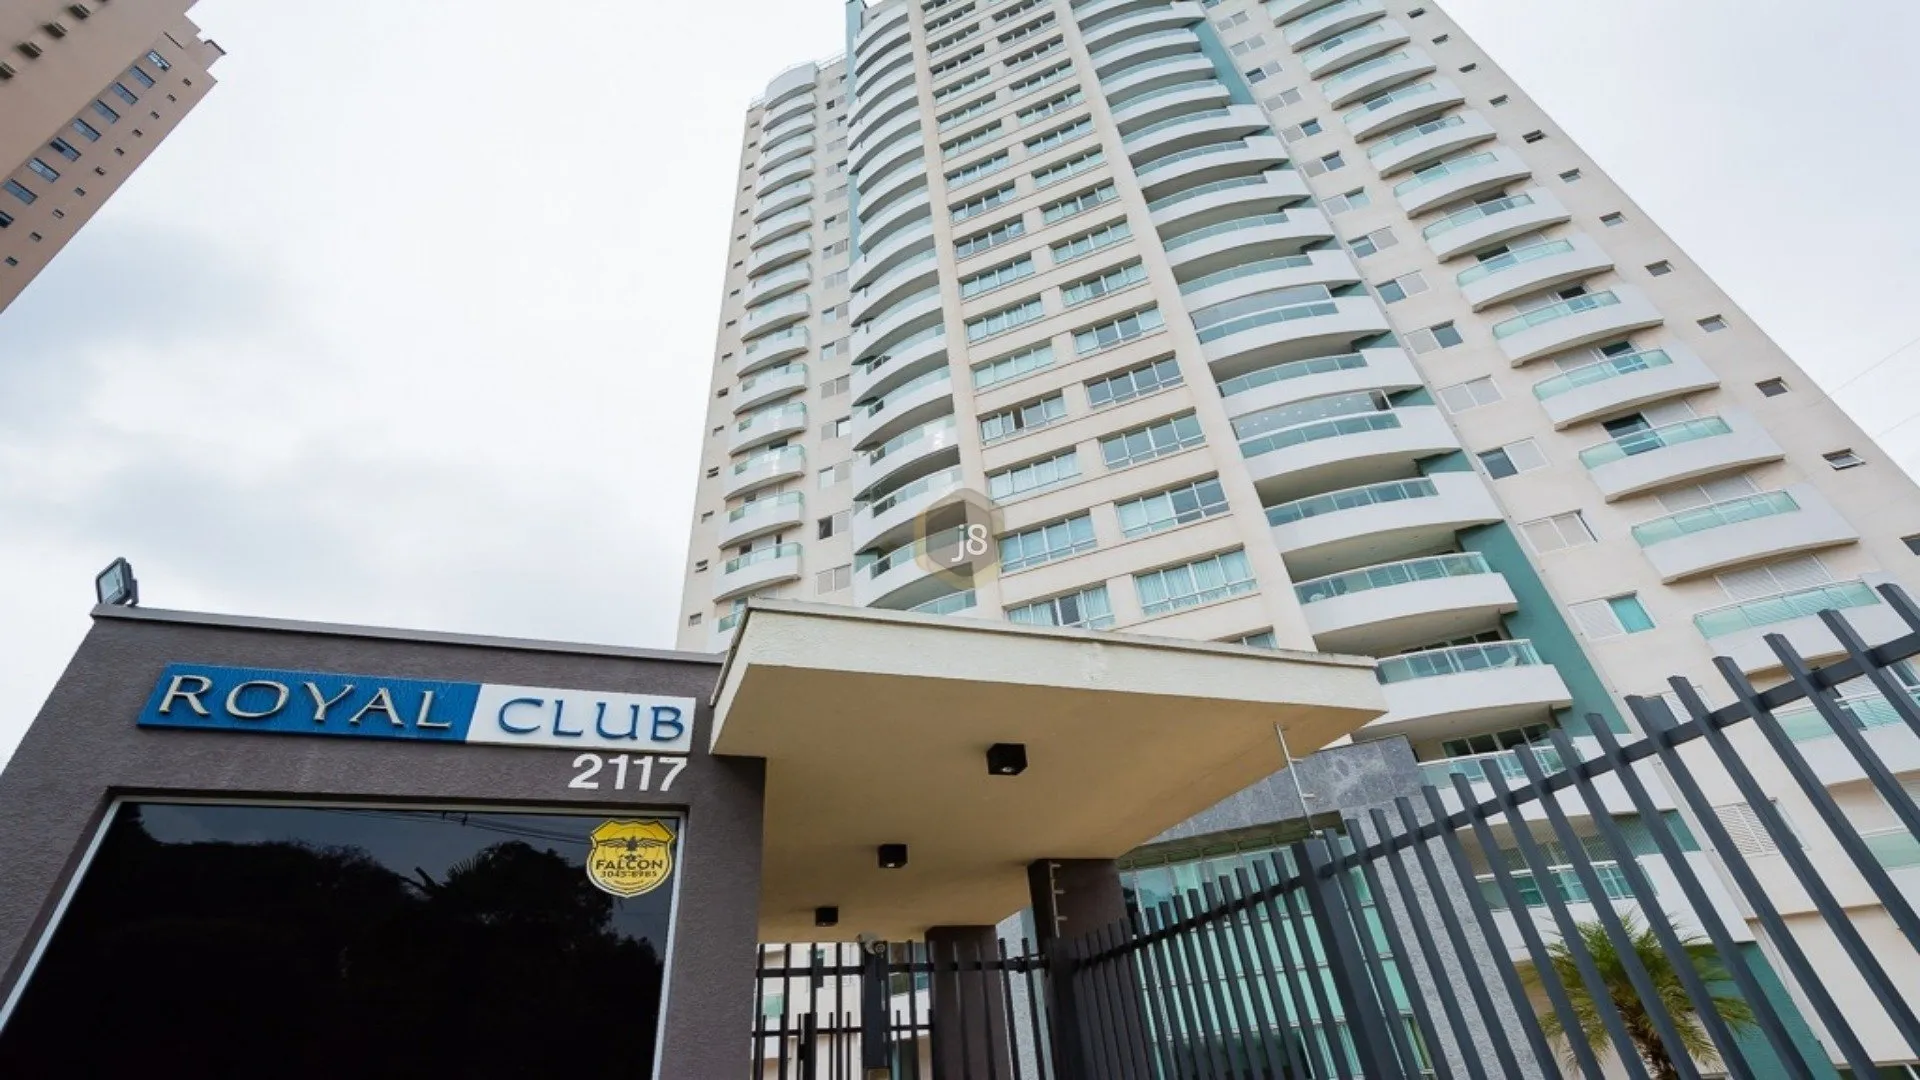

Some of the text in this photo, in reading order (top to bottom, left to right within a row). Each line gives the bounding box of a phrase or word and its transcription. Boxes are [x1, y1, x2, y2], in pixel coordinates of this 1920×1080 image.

[158, 674, 685, 742] ROYAL CLUB
[567, 753, 688, 792] 2117
[595, 859, 663, 871] FALCON
